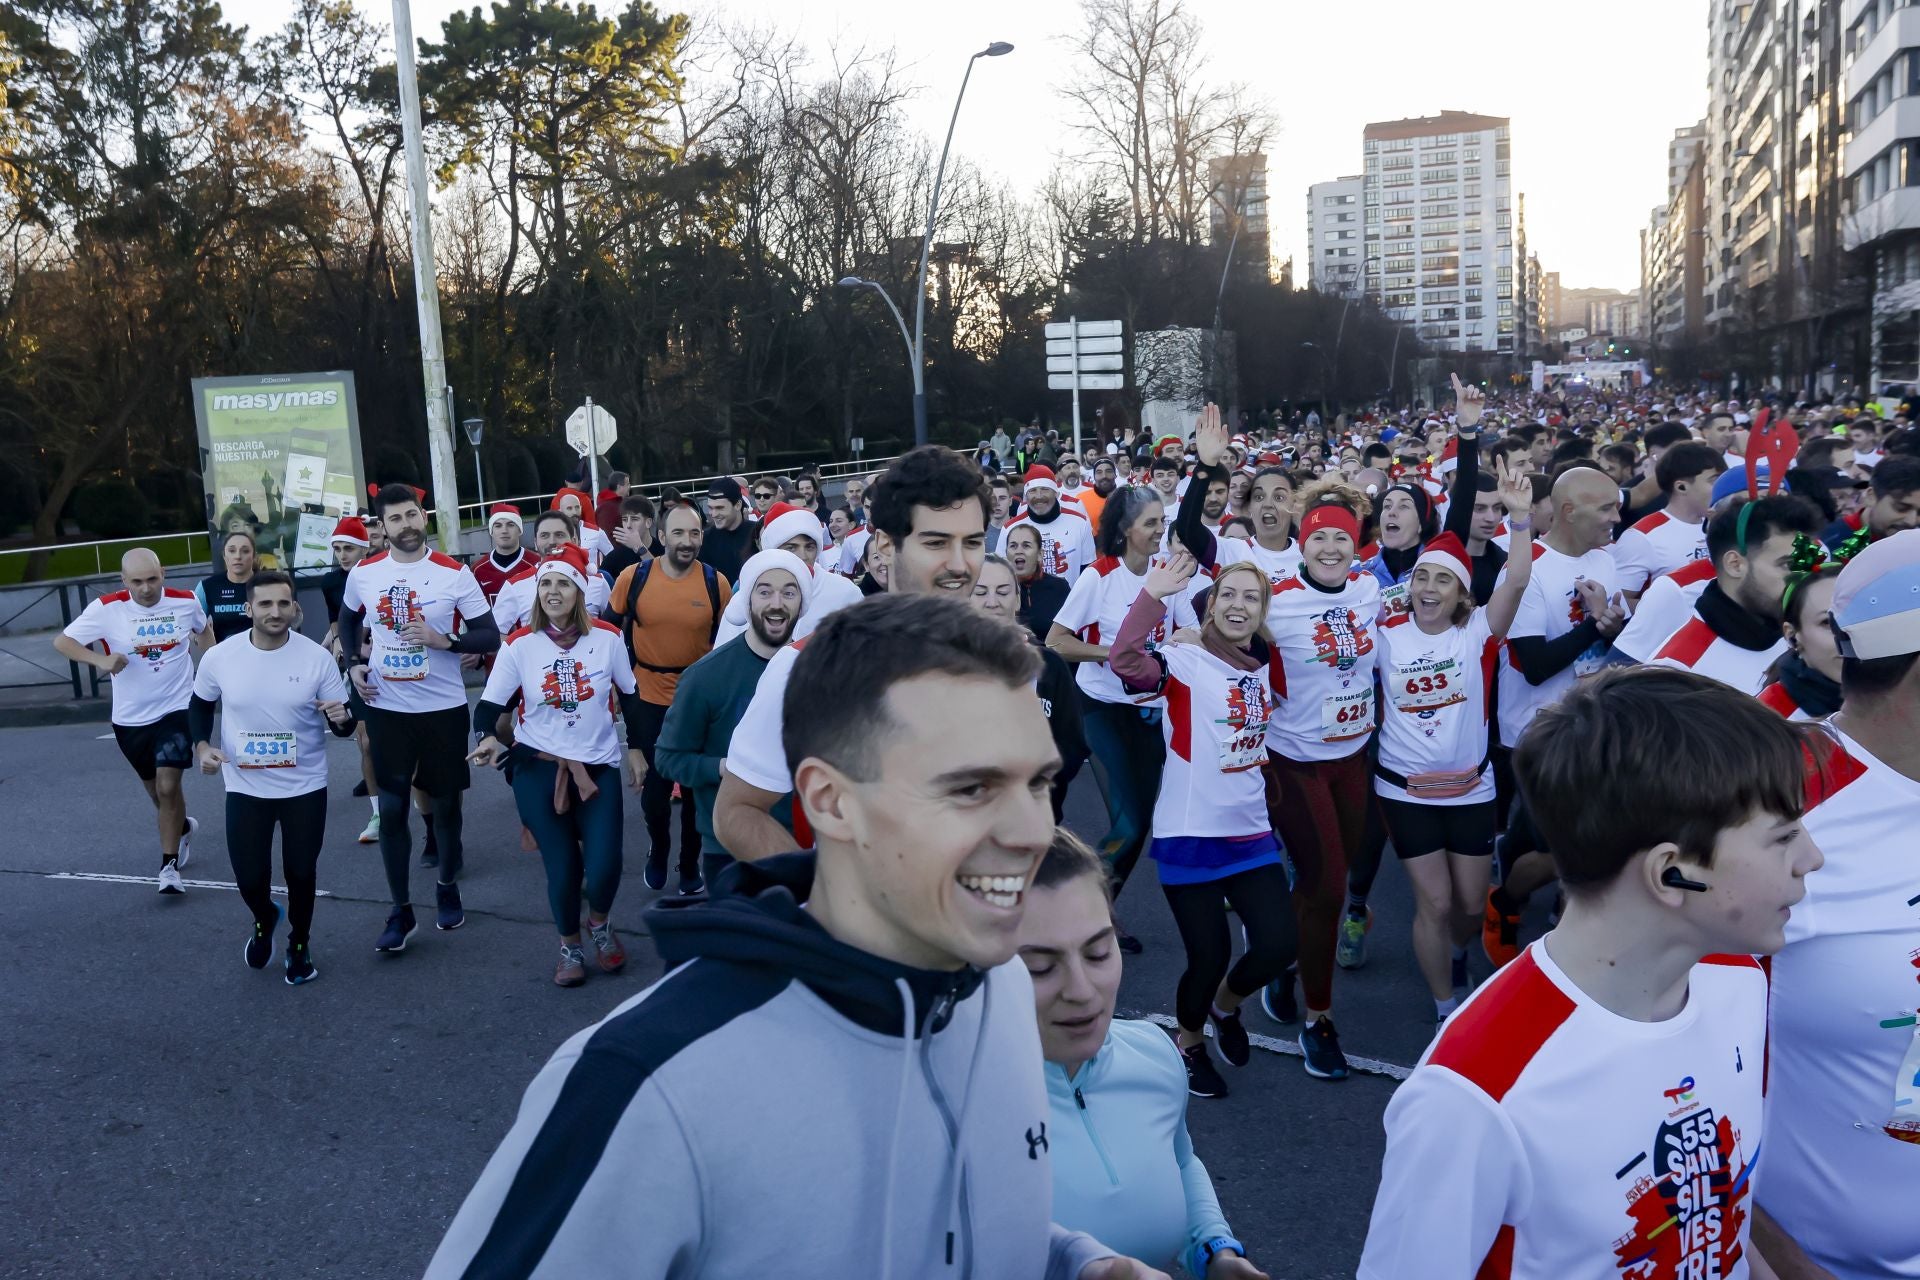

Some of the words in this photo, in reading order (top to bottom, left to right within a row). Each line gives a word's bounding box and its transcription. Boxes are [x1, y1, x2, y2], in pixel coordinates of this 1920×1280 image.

[213, 389, 338, 412] masymas
[214, 441, 265, 452] DESCARGA
[215, 450, 260, 462] NUESTRA
[261, 449, 280, 460] APP
[392, 592, 409, 600] SAN
[392, 599, 408, 608] SIL
[392, 607, 409, 616] VES
[1335, 609, 1347, 618] 55
[391, 615, 409, 624] TRE
[1326, 616, 1348, 625] SAN
[137, 623, 175, 637] 4463
[1331, 624, 1351, 635] SIL
[1334, 634, 1356, 646] VES
[1335, 644, 1357, 658] TRE
[383, 654, 424, 668] 4330
[556, 666, 575, 674] SAN
[558, 673, 576, 684] SIL
[1406, 673, 1448, 695] 633
[559, 682, 577, 692] VES
[559, 691, 578, 703] TRE
[1244, 694, 1262, 705] SIL
[1245, 704, 1263, 716] VES
[1336, 701, 1368, 723] 628
[244, 741, 288, 756] 4331
[1681, 1112, 1716, 1151] 55
[1667, 1145, 1720, 1186] SAN
[1677, 1174, 1720, 1222] SIL
[1679, 1207, 1722, 1258] VES
[1675, 1241, 1722, 1280] TRE
